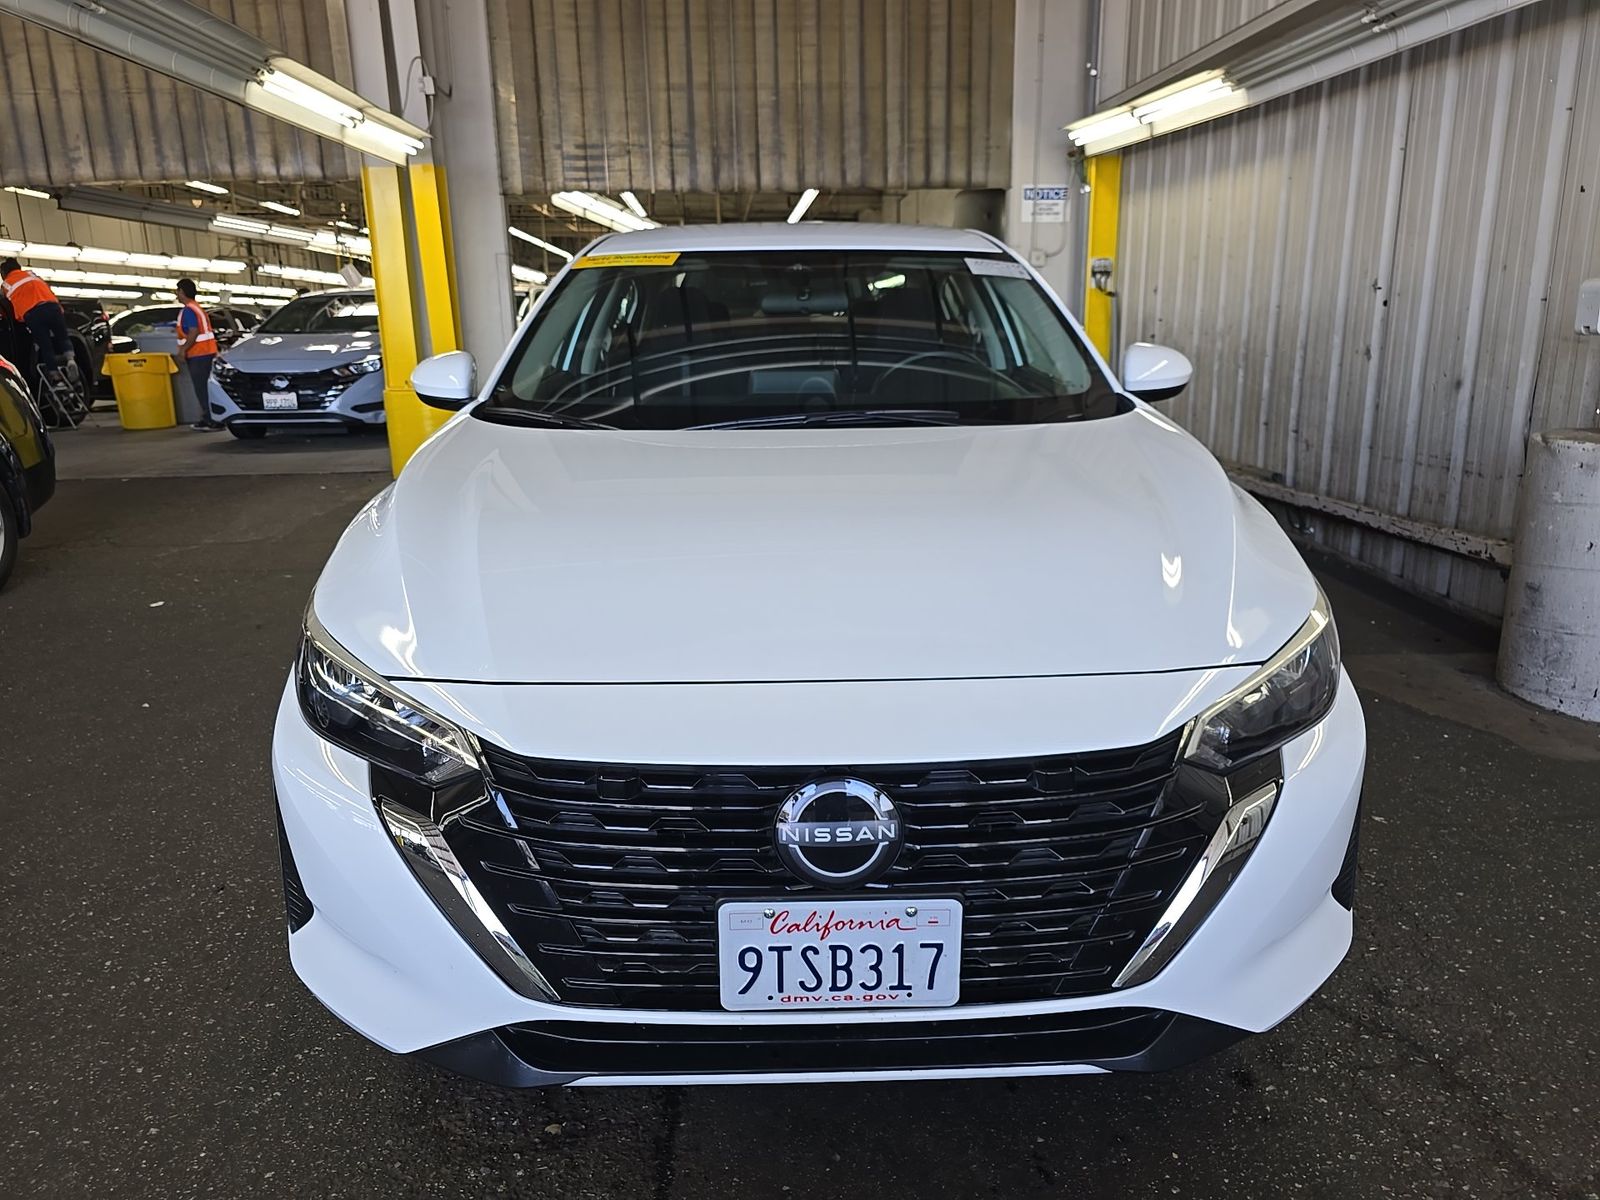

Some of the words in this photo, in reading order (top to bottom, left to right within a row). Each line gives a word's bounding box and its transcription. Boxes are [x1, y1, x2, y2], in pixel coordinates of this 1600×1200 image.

[1024, 189, 1068, 200] NOTICE
[781, 823, 896, 843] NISSAN
[770, 910, 917, 941] California
[737, 942, 945, 995] 9TSB317
[780, 992, 900, 1004] dmv.ca.gov
